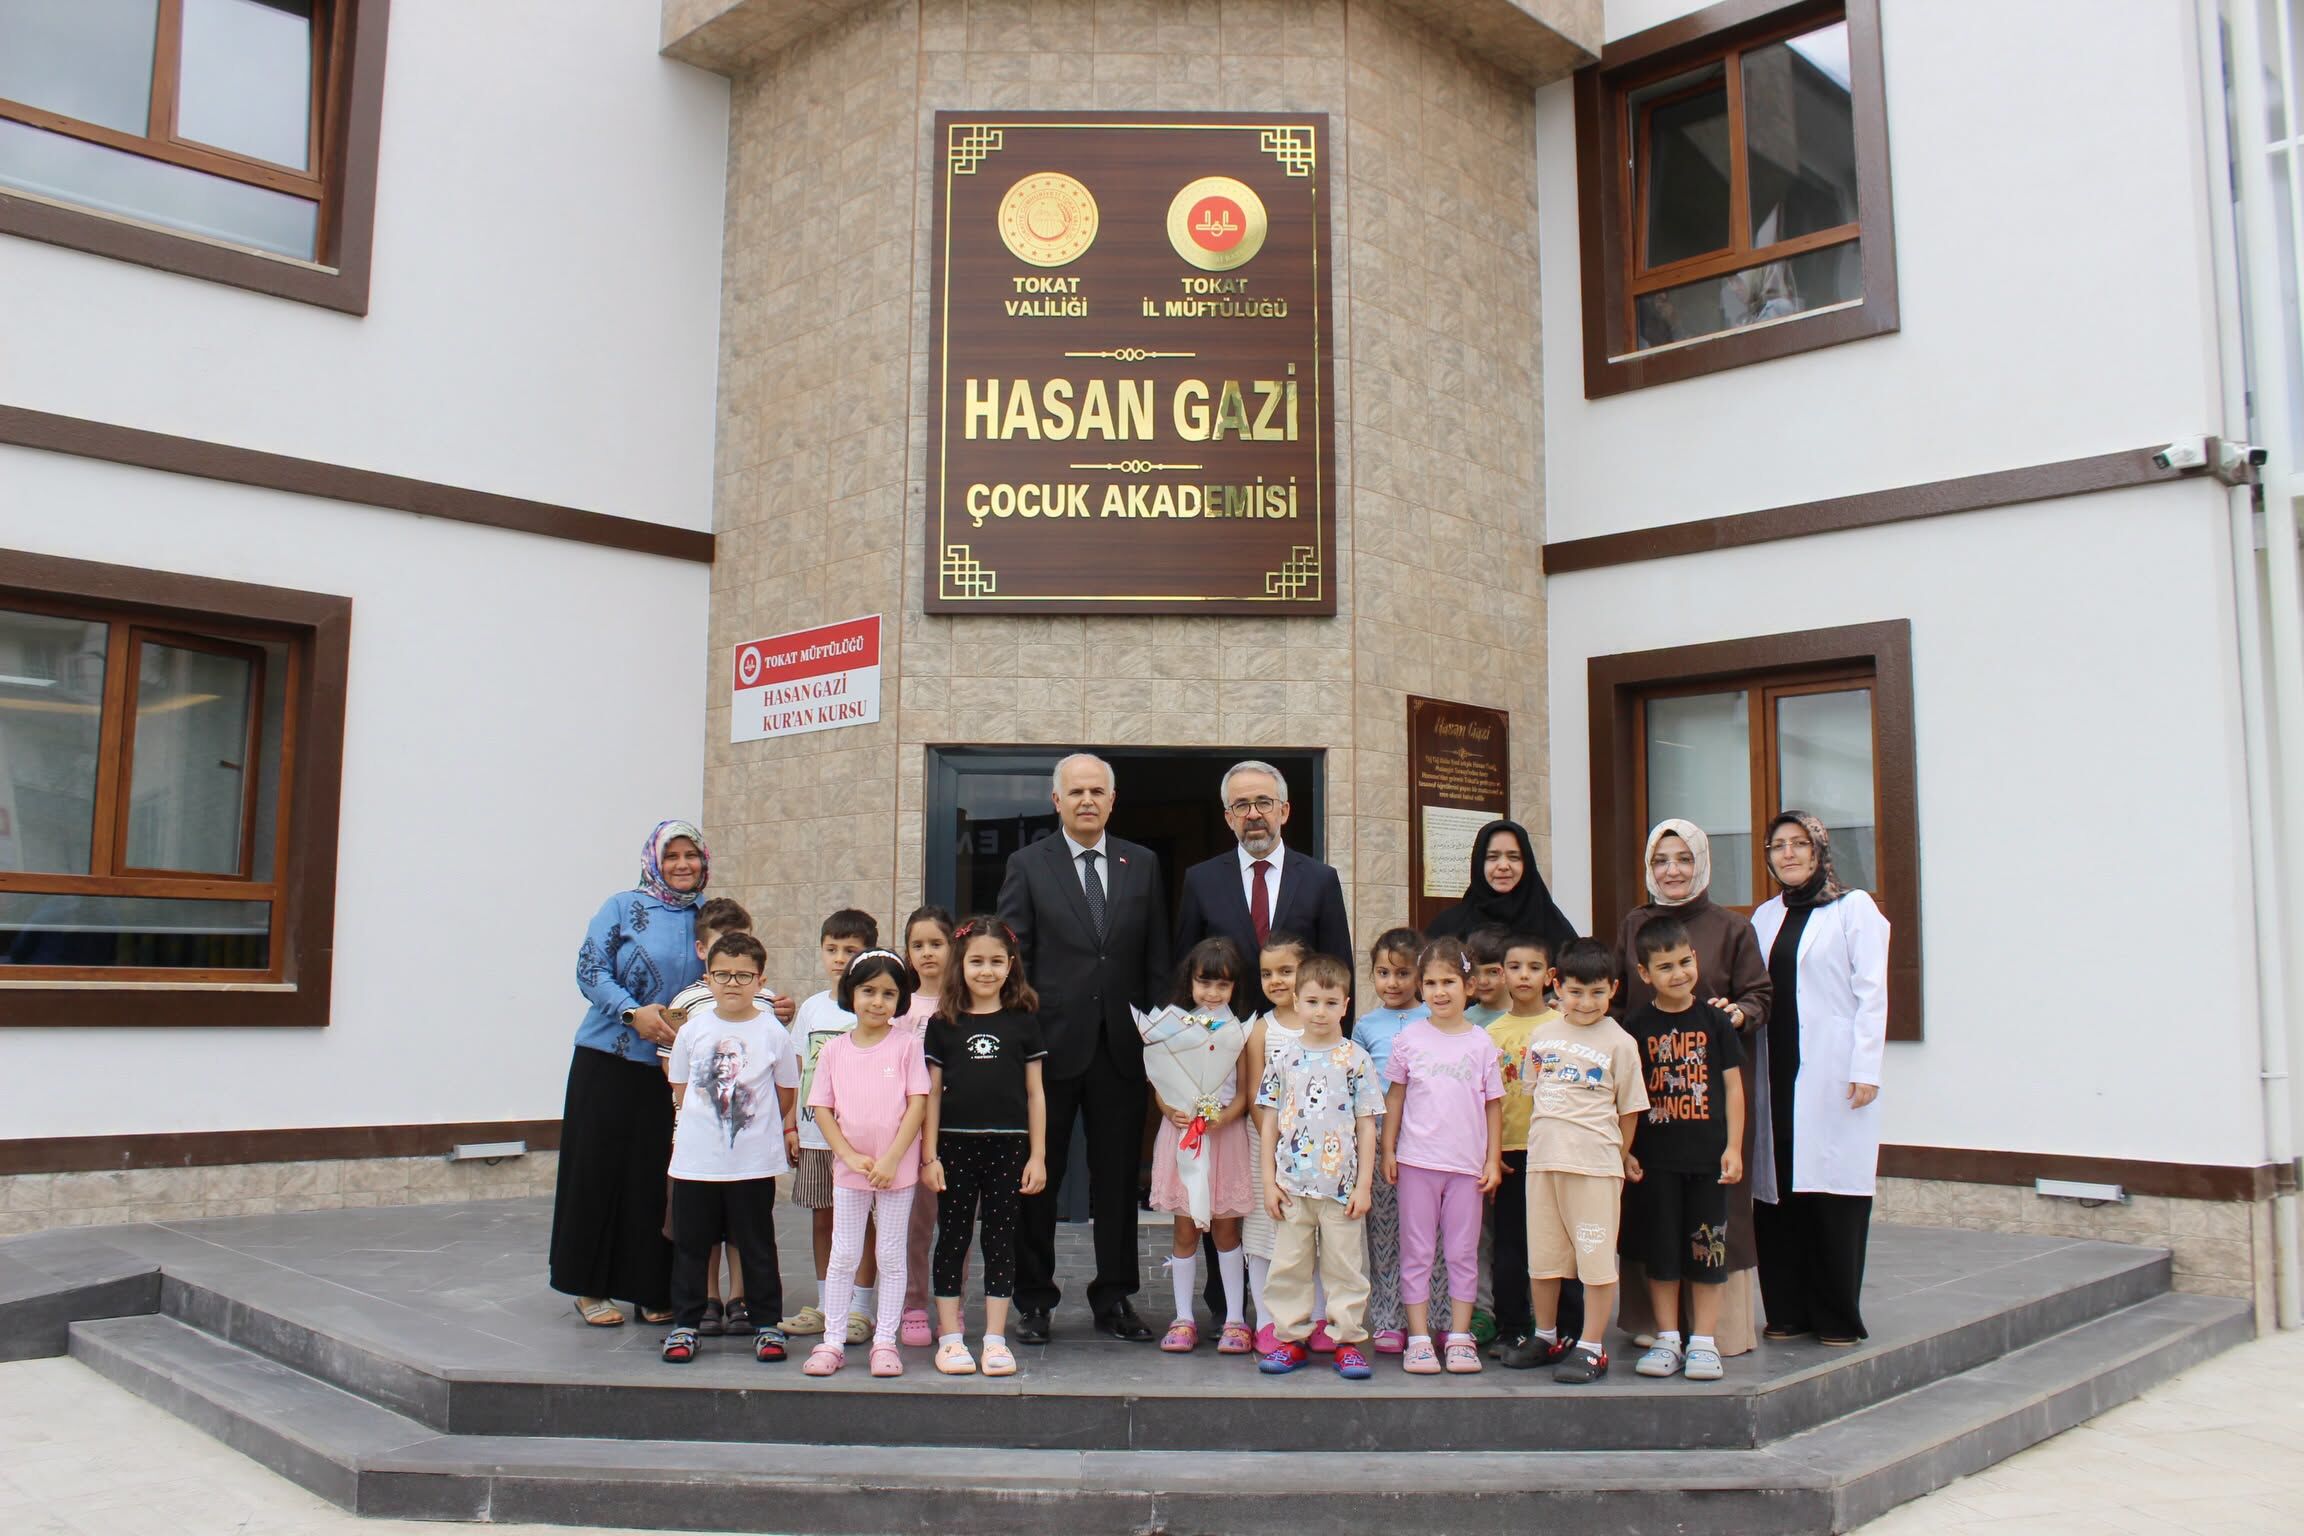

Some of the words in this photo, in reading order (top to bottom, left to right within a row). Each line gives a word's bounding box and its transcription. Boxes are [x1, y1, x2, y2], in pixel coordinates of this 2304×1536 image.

[1013, 277, 1081, 294] TOKAT
[1181, 278, 1249, 294] TOKAT
[1005, 296, 1088, 317] VALİLİĞİ
[1142, 297, 1160, 317] İL
[1165, 297, 1288, 318] MÜFTÜLÜĞÜ
[965, 378, 1154, 441] HASAN
[1173, 362, 1298, 442] GAZİ
[966, 483, 1091, 528] ÇOCUK
[1100, 476, 1297, 519] AKADEMİSİ
[764, 652, 798, 669] TOKAT
[800, 635, 865, 662] MÜFTÜLÜĞÜ
[763, 683, 811, 707] HASAN
[813, 673, 848, 699] GAZİ
[818, 700, 868, 723] KURSU
[1649, 1066, 1669, 1091] OF
